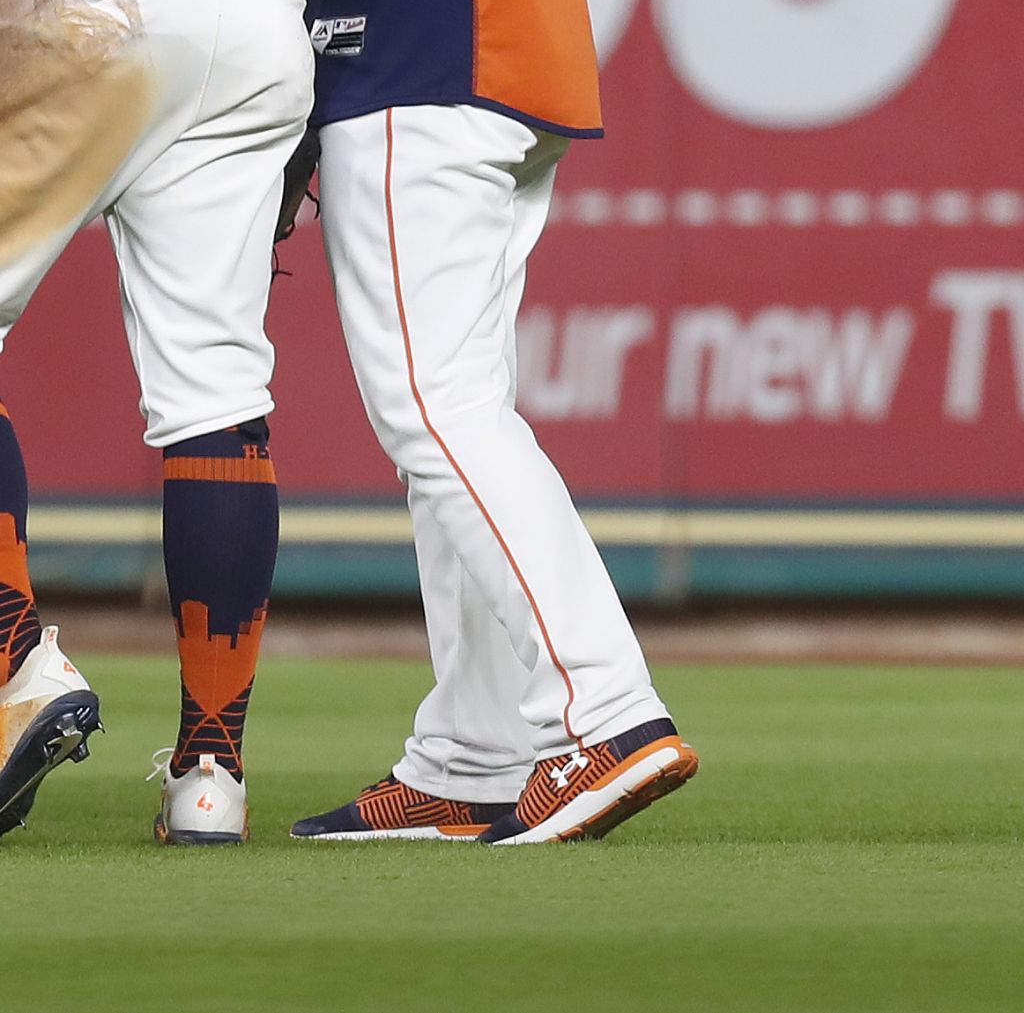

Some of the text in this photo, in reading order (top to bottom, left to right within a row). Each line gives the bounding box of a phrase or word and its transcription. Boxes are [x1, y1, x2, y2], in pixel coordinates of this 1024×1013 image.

[664, 304, 918, 424] new
[928, 266, 1024, 425] T
[196, 791, 214, 813] 4
